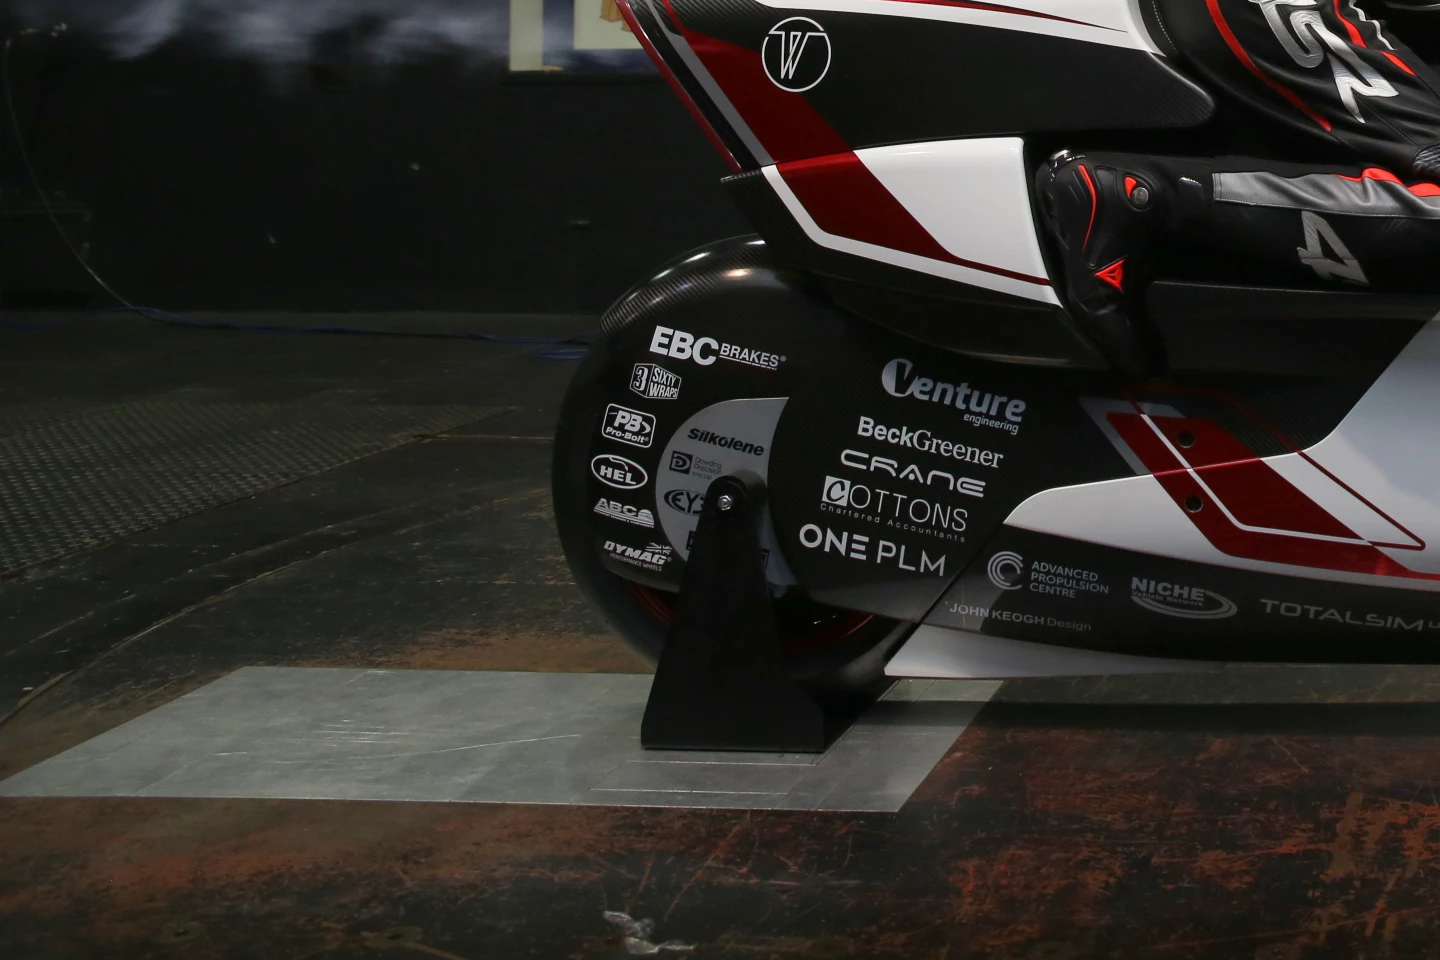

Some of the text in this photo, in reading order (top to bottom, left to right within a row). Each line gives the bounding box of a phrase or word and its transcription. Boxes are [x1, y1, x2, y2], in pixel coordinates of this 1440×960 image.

[649, 325, 719, 366] EBC
[633, 365, 649, 385] 3
[652, 367, 677, 387] SIXTY
[650, 382, 678, 398] WRAPS
[881, 358, 1026, 422] Venture
[613, 410, 643, 433] PB
[963, 413, 1019, 435] engineering
[687, 427, 764, 456] Silkolene
[857, 415, 1004, 468] BeckGreener
[600, 465, 637, 485] HEL
[840, 449, 986, 498] CRANE
[594, 497, 638, 517] ABC
[822, 475, 968, 532] COTTONS
[820, 503, 966, 543] Chartered Accountants
[603, 540, 667, 566] DYMAG
[799, 523, 946, 577] ONE PLM
[1030, 572, 1109, 594] PROPULSION
[1031, 561, 1099, 581] ADVANCED
[1029, 583, 1076, 598] CENTRE
[1131, 576, 1205, 601] NICHE
[1131, 590, 1204, 607] Vehicle Network
[950, 603, 1092, 632] JOHN KEOGH Design
[1259, 598, 1423, 632] TOTALSIM
